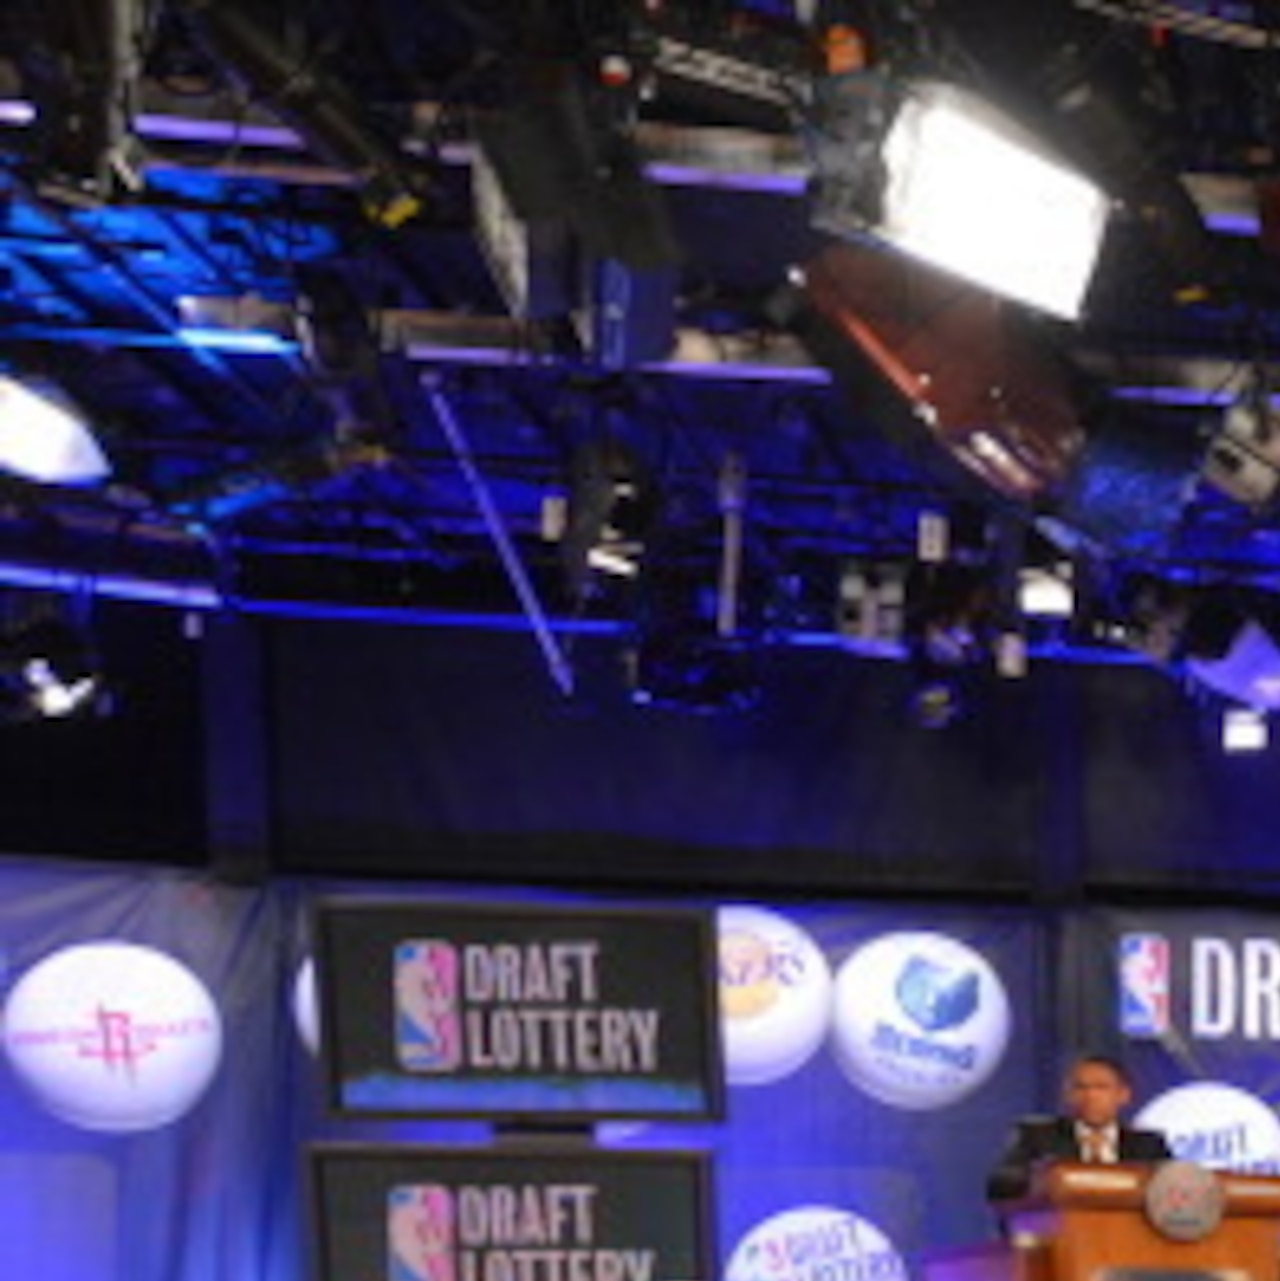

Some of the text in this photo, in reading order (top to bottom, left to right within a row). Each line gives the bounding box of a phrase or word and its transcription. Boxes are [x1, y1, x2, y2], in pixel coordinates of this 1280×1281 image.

[464, 942, 599, 1001] DRAFT
[467, 1008, 659, 1072] LOTTERY
[459, 1185, 598, 1245] DRAFT
